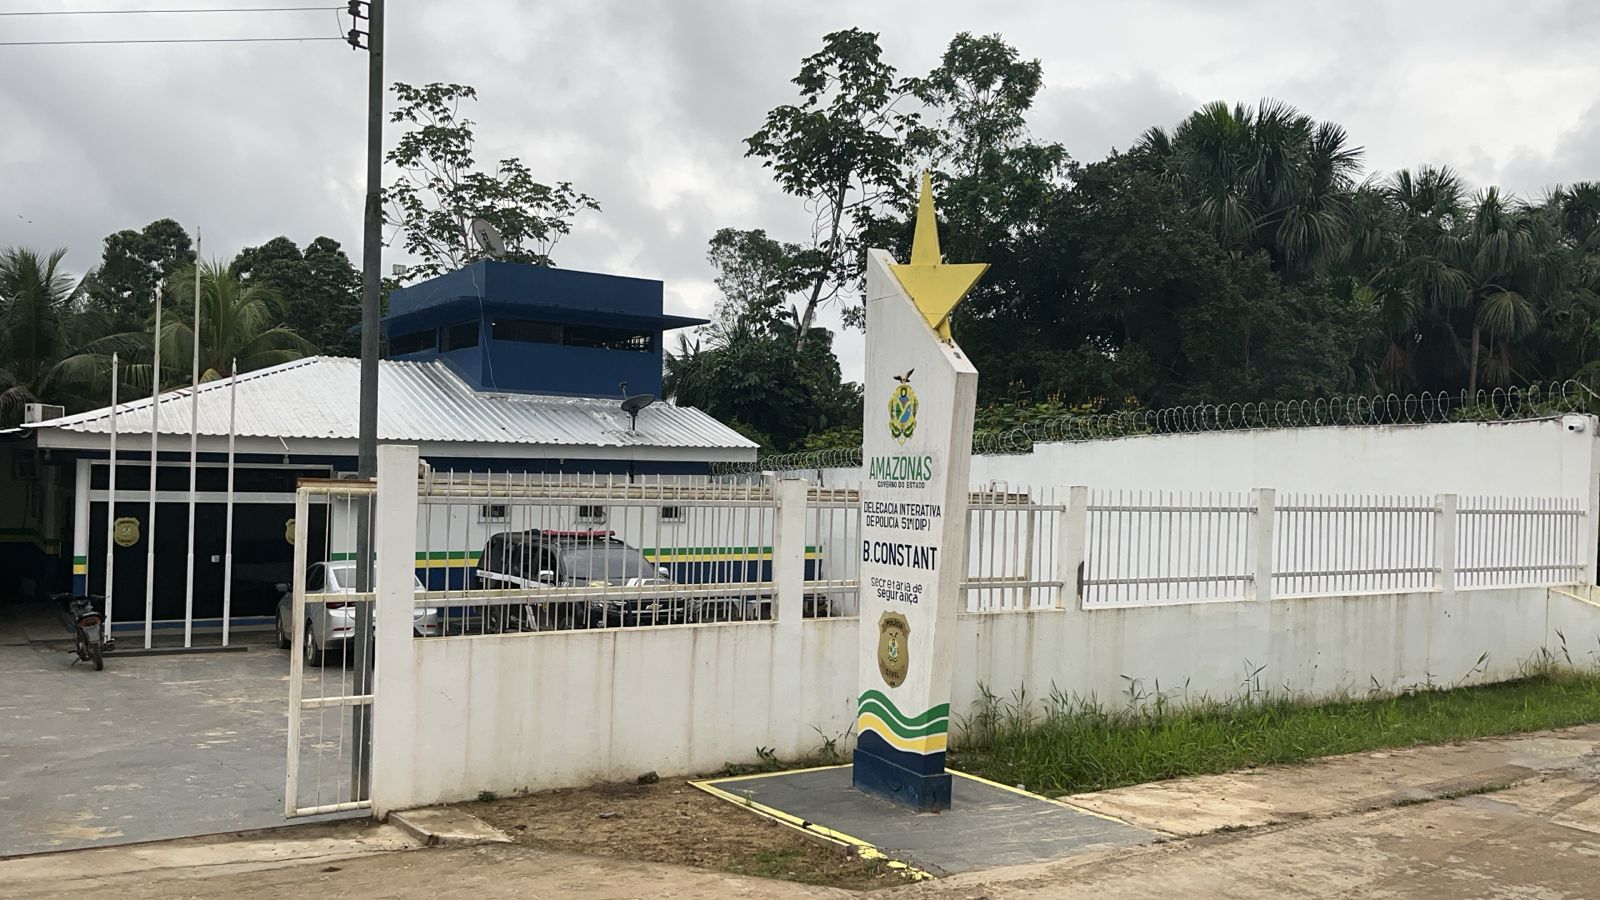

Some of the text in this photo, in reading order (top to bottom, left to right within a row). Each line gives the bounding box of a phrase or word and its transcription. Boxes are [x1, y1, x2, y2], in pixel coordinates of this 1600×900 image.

[869, 456, 932, 481] AMAZONAS
[899, 503, 941, 517] INTERATIVA
[866, 515, 875, 527] DE
[912, 584, 923, 594] de
[877, 588, 918, 605] segurança
